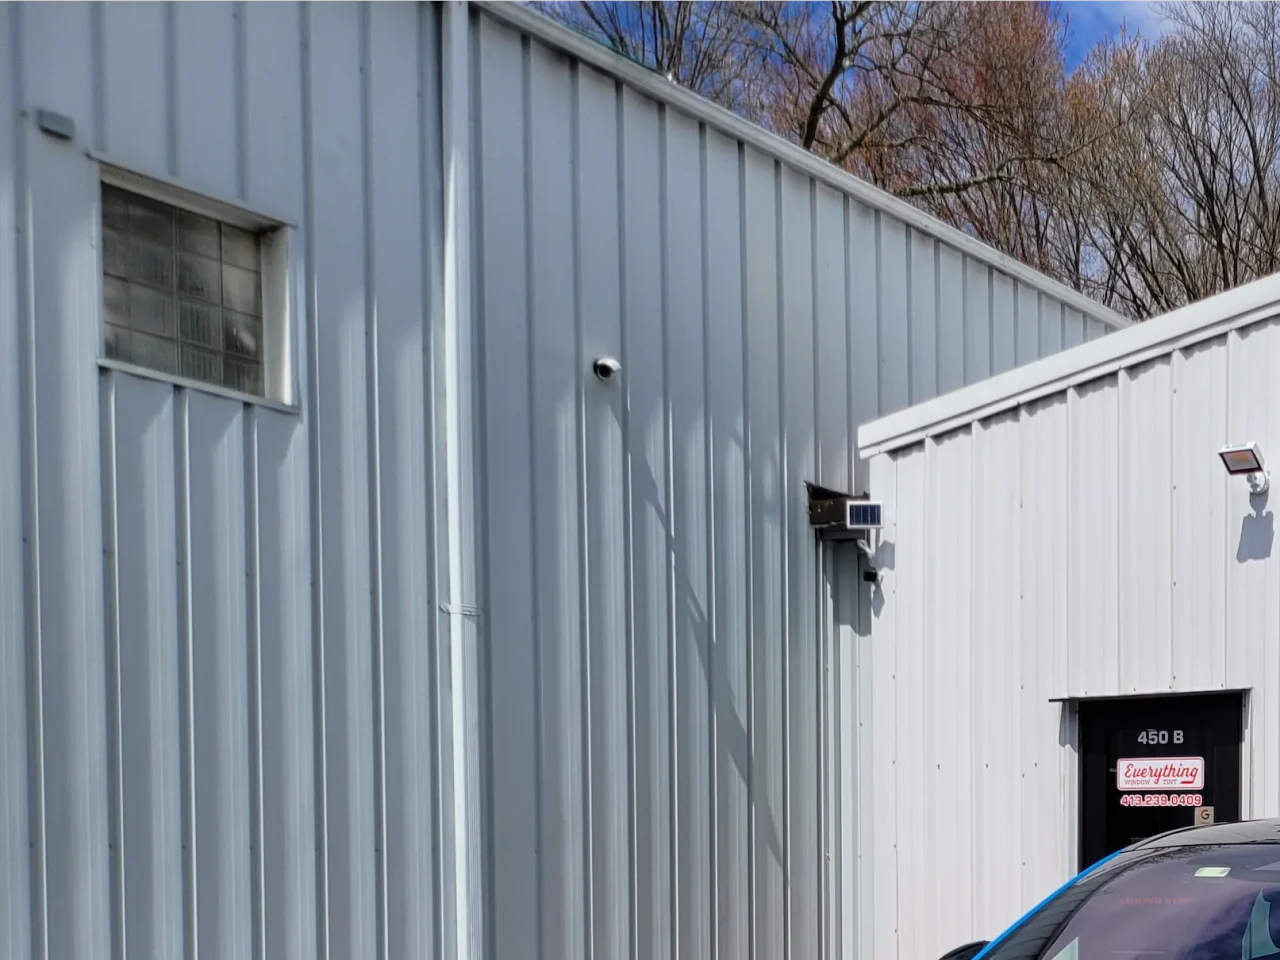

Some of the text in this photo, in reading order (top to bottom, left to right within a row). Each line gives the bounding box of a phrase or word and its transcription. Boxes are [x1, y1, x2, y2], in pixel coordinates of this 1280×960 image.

[1137, 730, 1184, 745] 450 B
[1124, 763, 1199, 785] Everything
[1121, 794, 1202, 806] 413.239.0409
[1200, 809, 1210, 820] G
